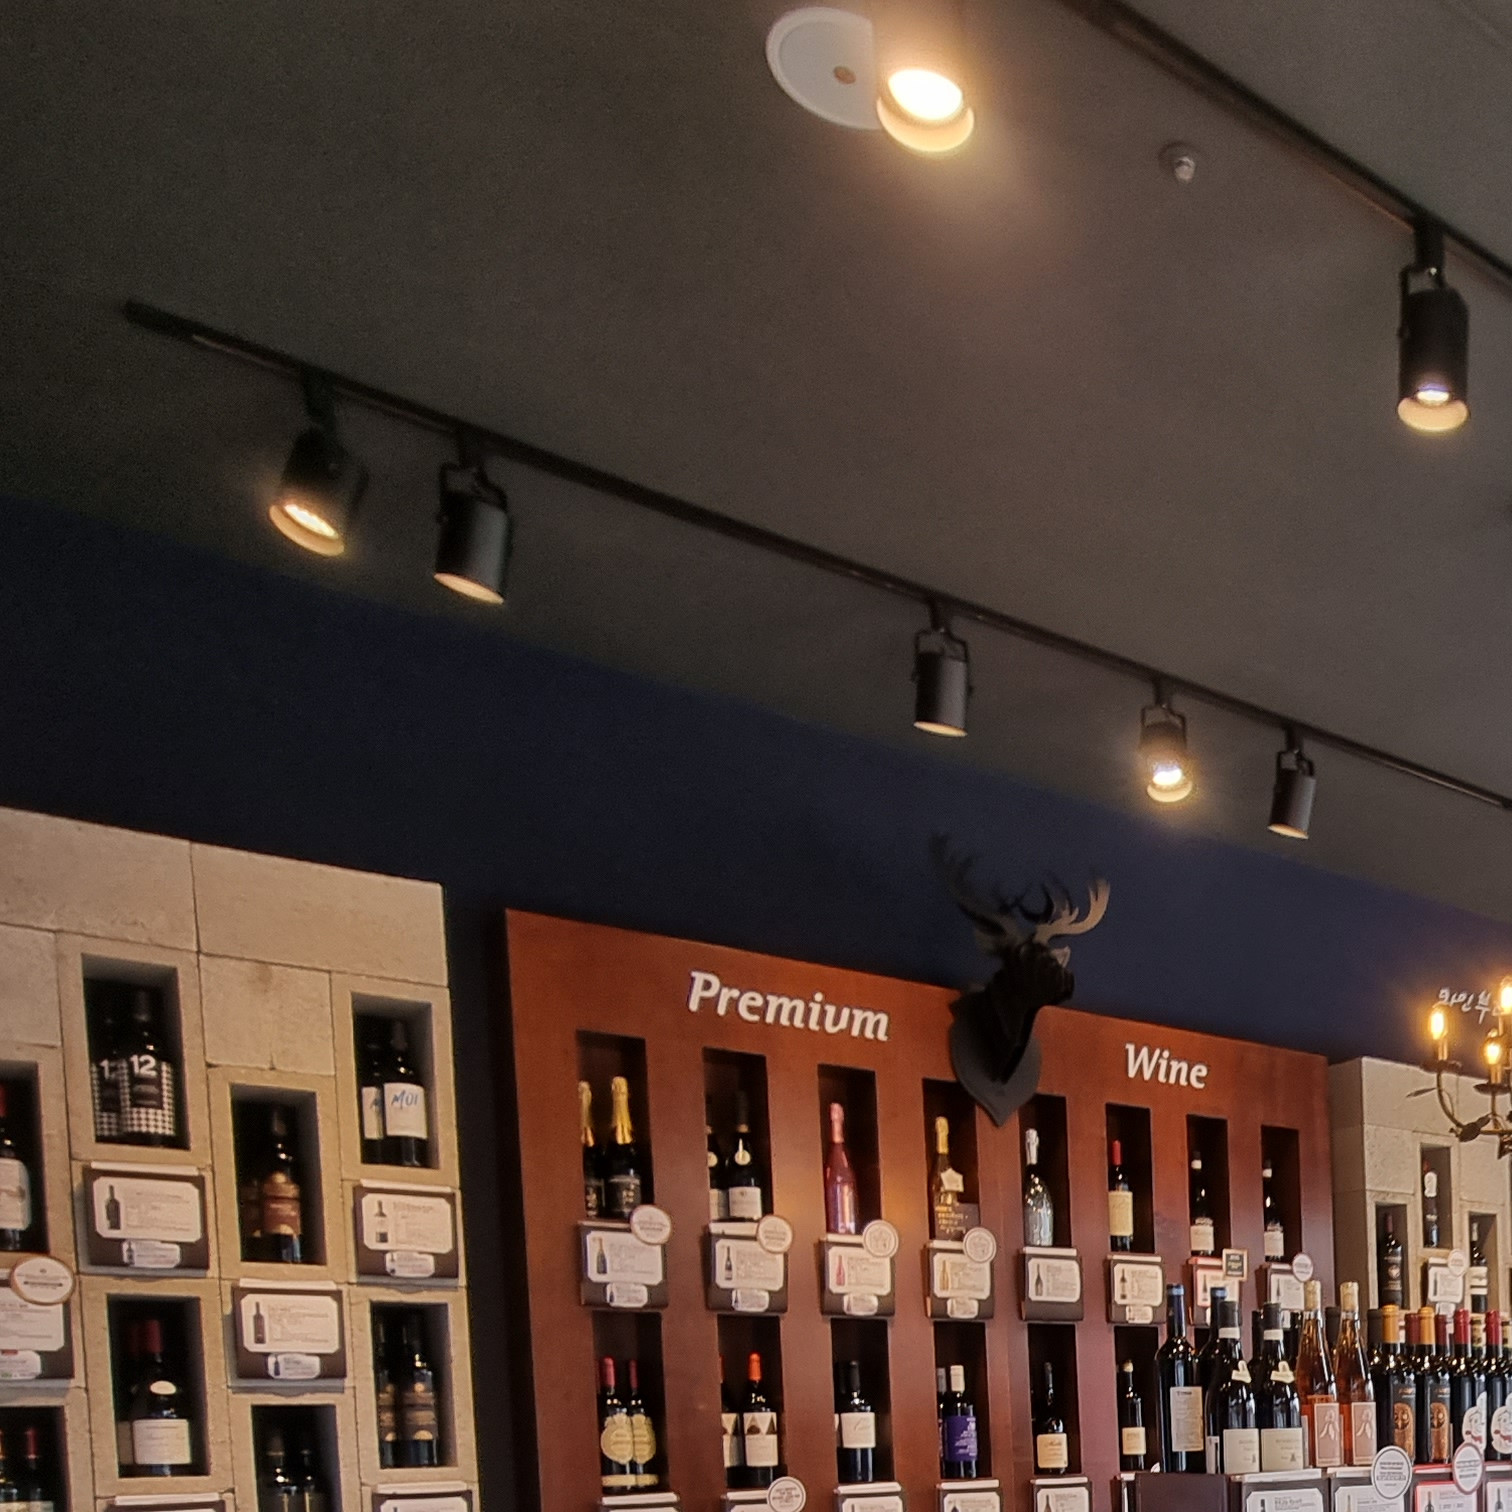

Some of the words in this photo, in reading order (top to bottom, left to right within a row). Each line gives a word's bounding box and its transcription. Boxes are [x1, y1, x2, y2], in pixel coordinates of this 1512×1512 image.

[688, 970, 890, 1042] Premium
[130, 1054, 158, 1077] 12
[1125, 1043, 1209, 1089] Wine
